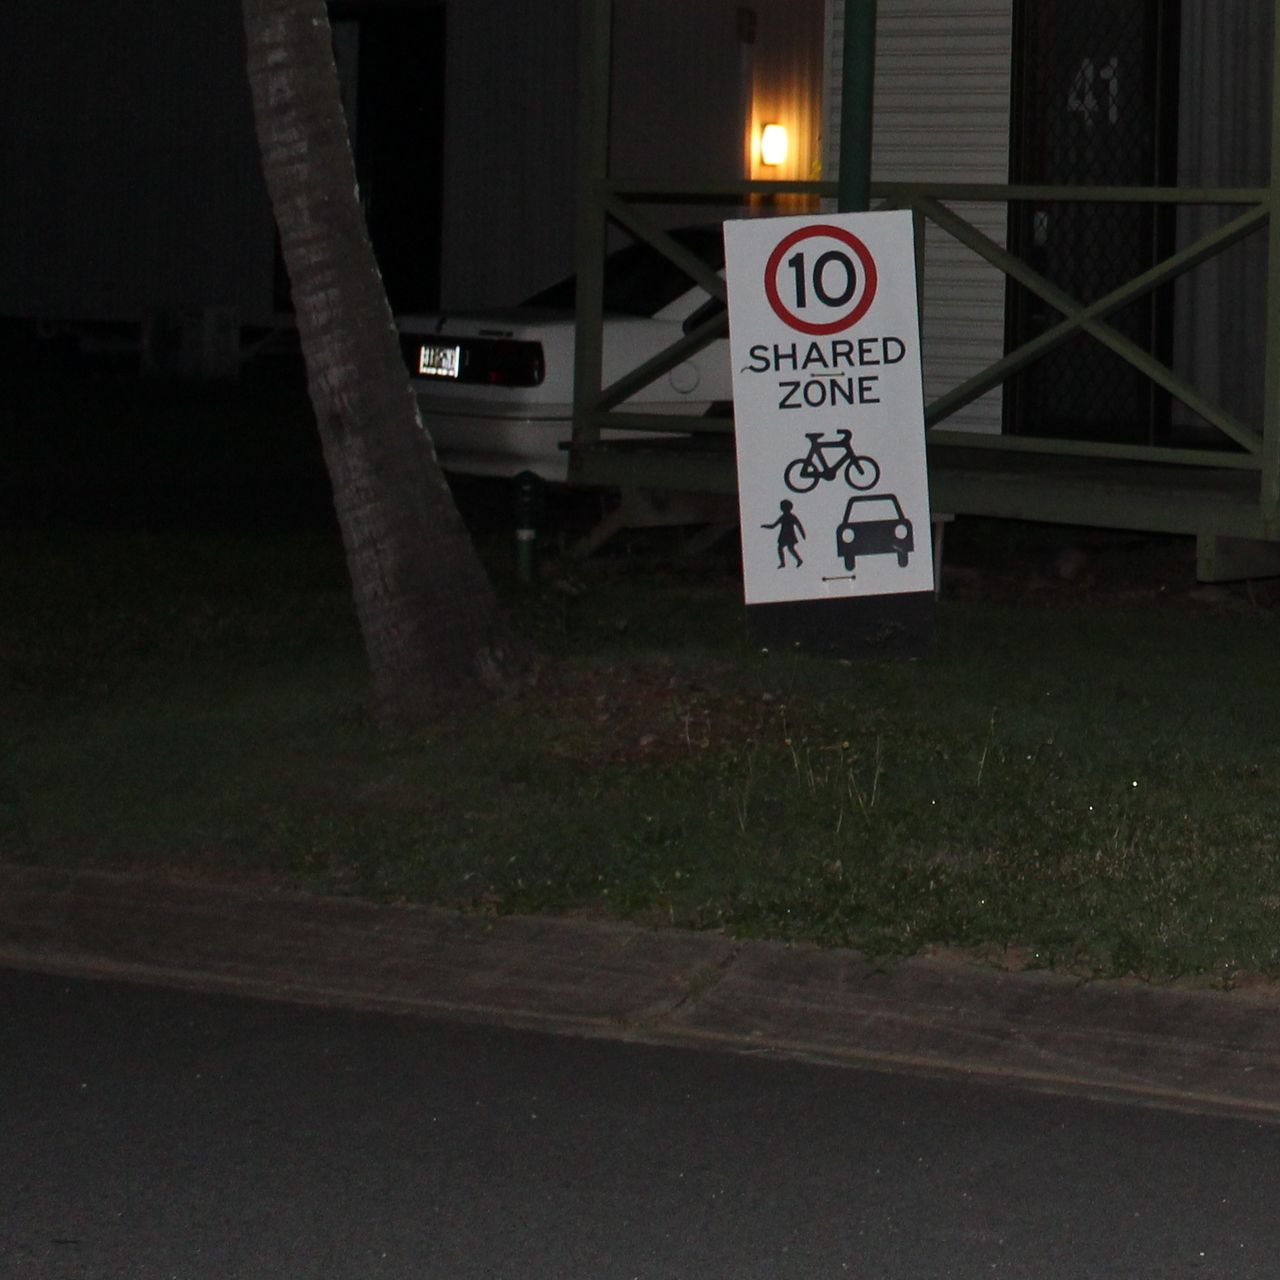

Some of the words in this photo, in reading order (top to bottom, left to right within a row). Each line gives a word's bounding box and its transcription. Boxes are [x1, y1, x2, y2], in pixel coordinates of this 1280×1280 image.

[1066, 57, 1119, 126] 41
[787, 250, 857, 309] 10
[748, 336, 906, 373] SHARED
[778, 376, 881, 409] ZONE
